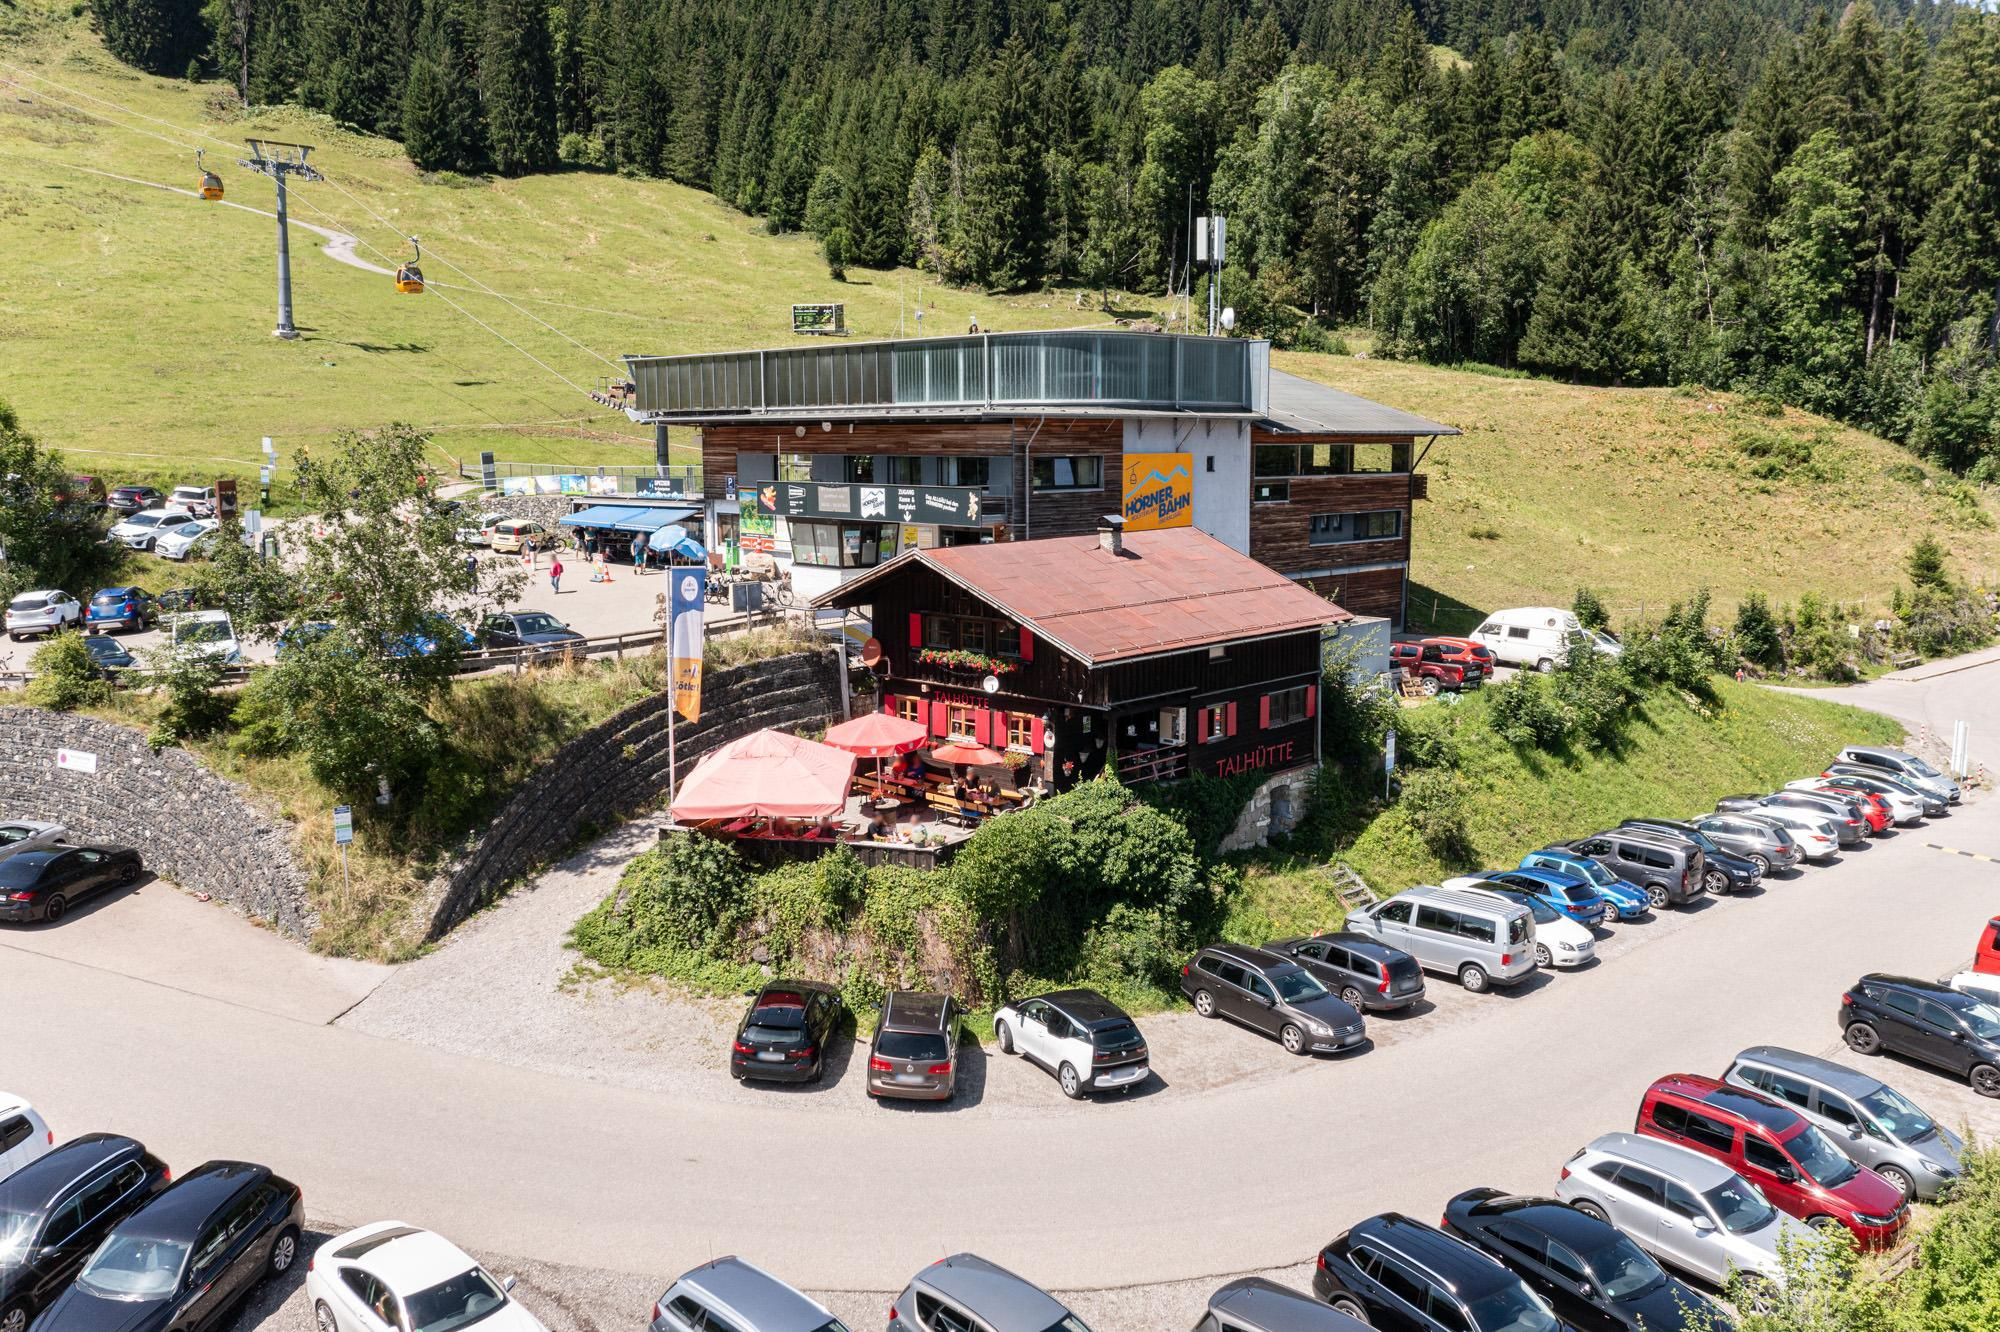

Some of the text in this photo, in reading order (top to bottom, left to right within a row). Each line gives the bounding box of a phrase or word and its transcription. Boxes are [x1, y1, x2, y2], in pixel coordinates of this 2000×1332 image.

[728, 477, 733, 485] P
[1126, 486, 1173, 517] HÖRNER
[1159, 492, 1190, 518] BAHN
[935, 690, 989, 709] TALHÜTTE
[1216, 741, 1294, 778] TALHÜTTE
